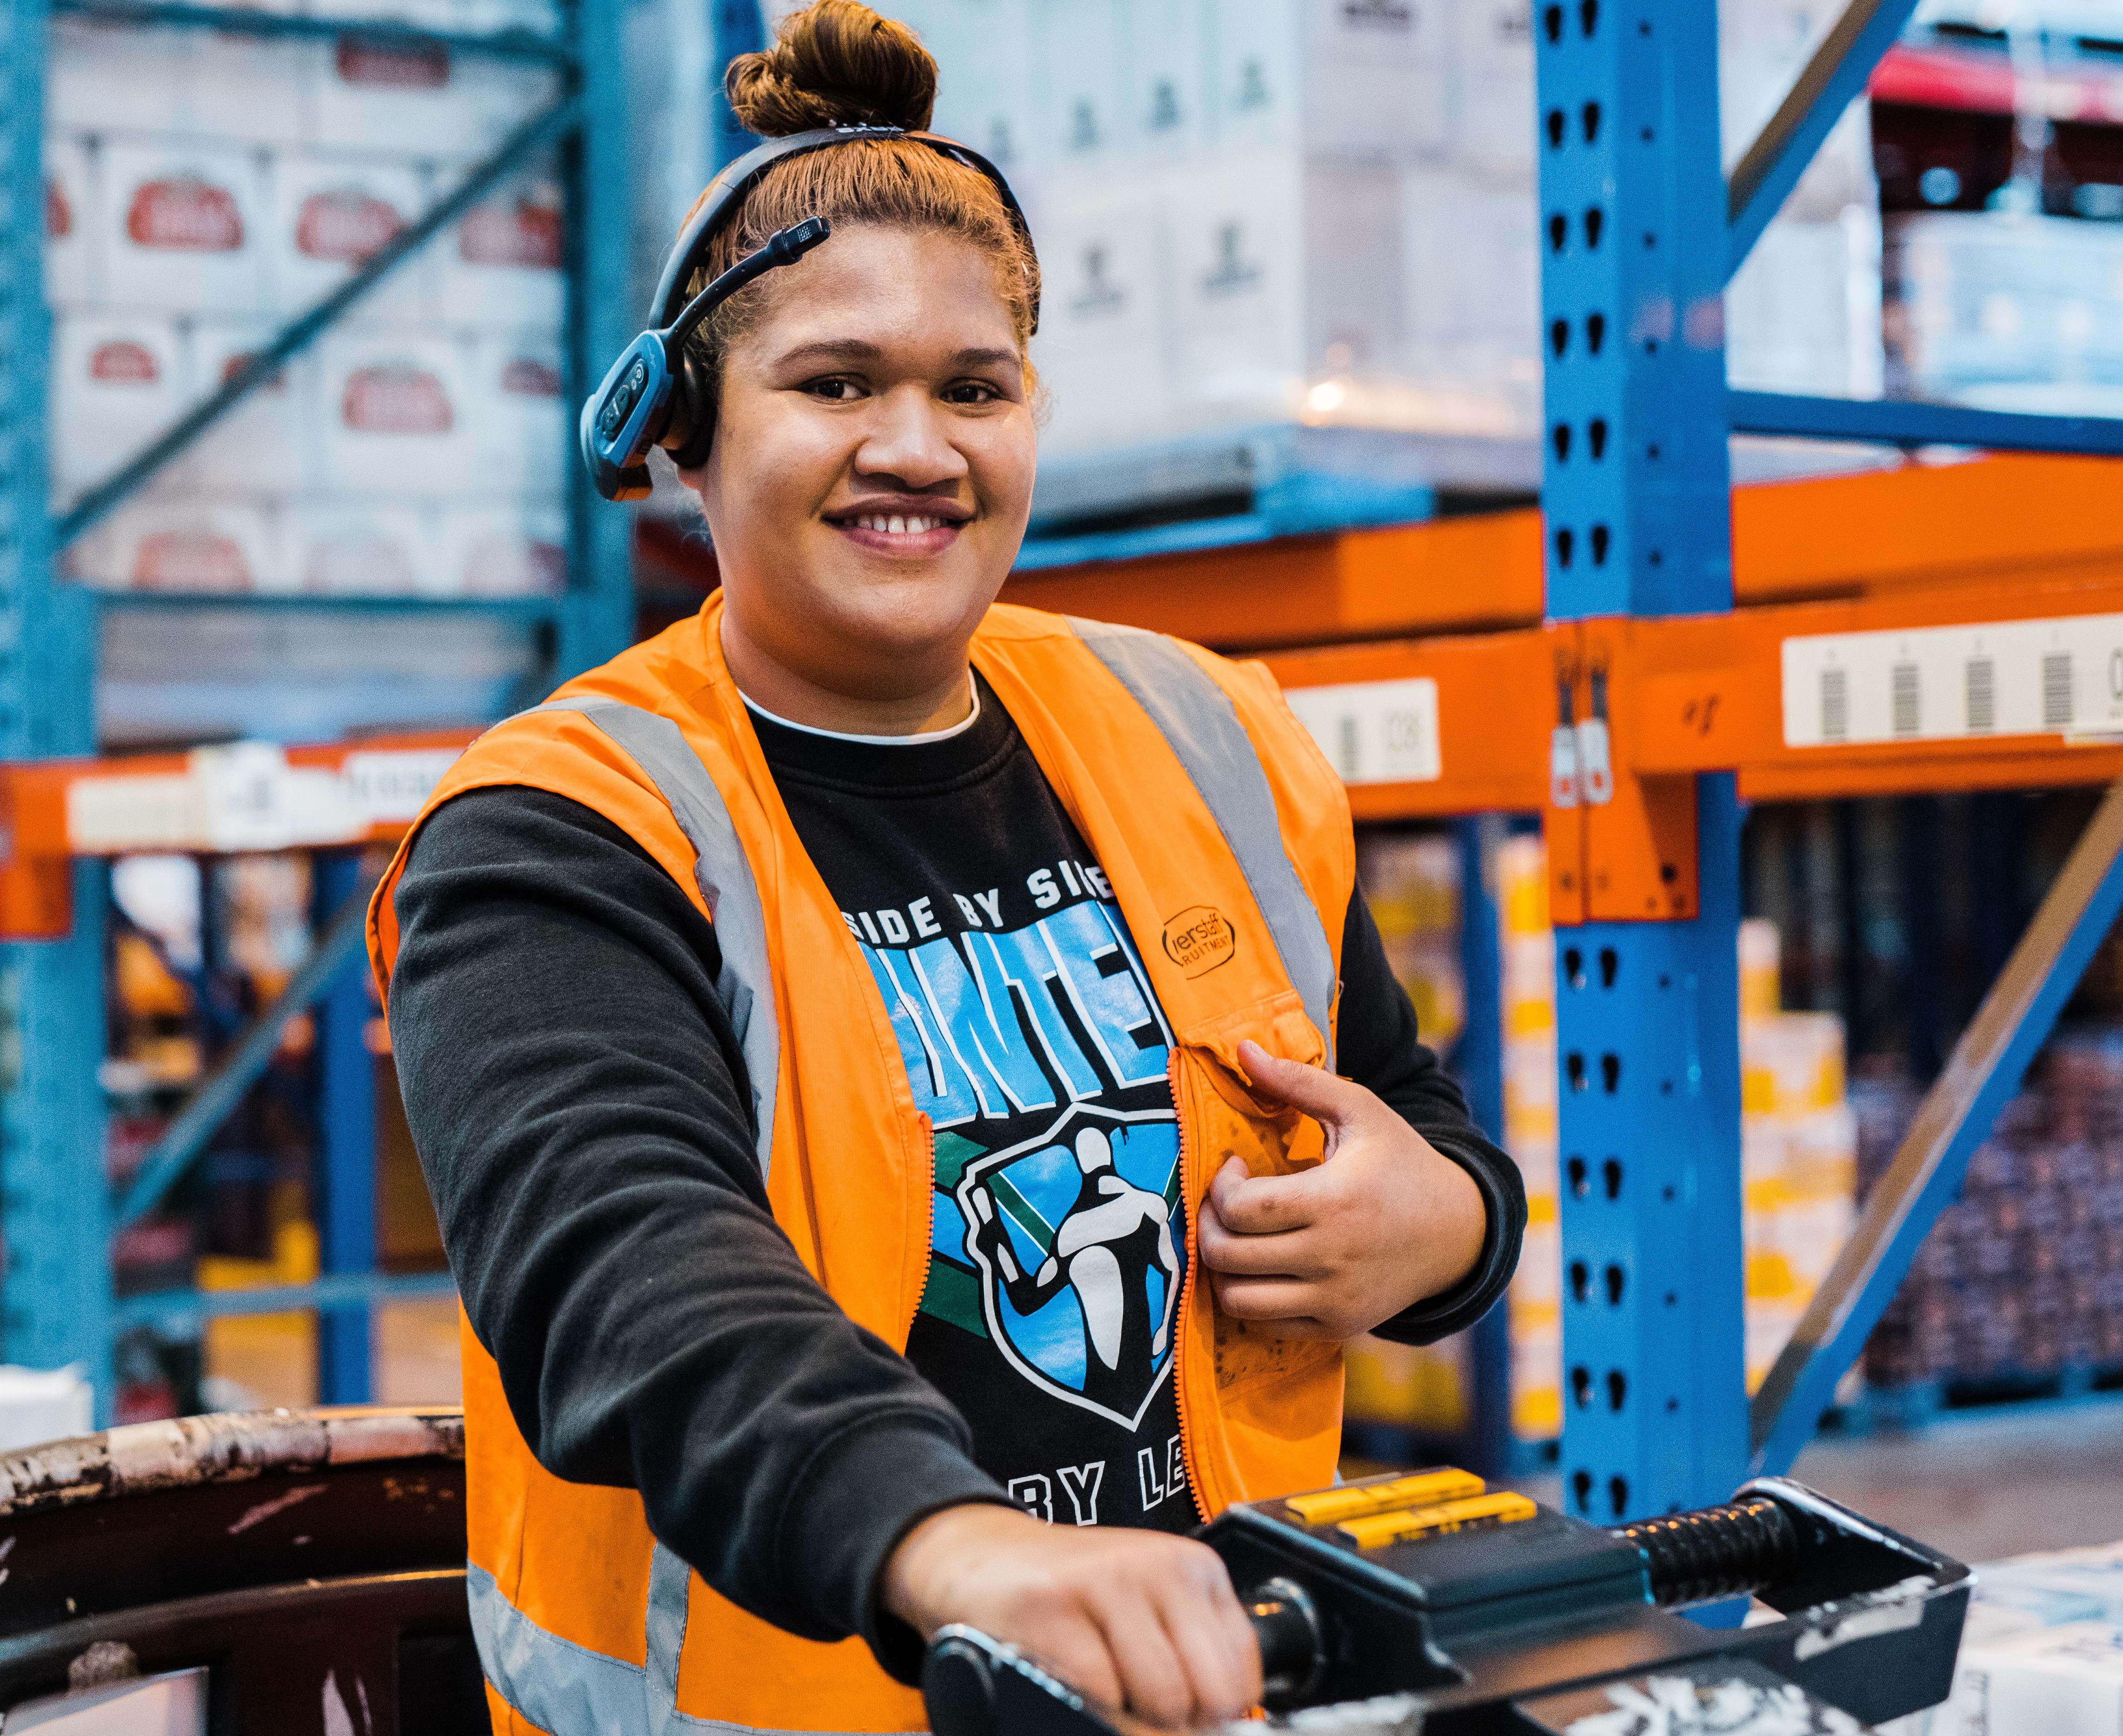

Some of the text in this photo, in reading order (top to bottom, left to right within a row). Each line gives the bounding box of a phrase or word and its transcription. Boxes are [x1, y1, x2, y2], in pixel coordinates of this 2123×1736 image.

[841, 896, 942, 944] SIDE
[953, 892, 1004, 928] BY
[858, 899, 1175, 1130] UNTE
[1008, 1460, 1105, 1527] BY
